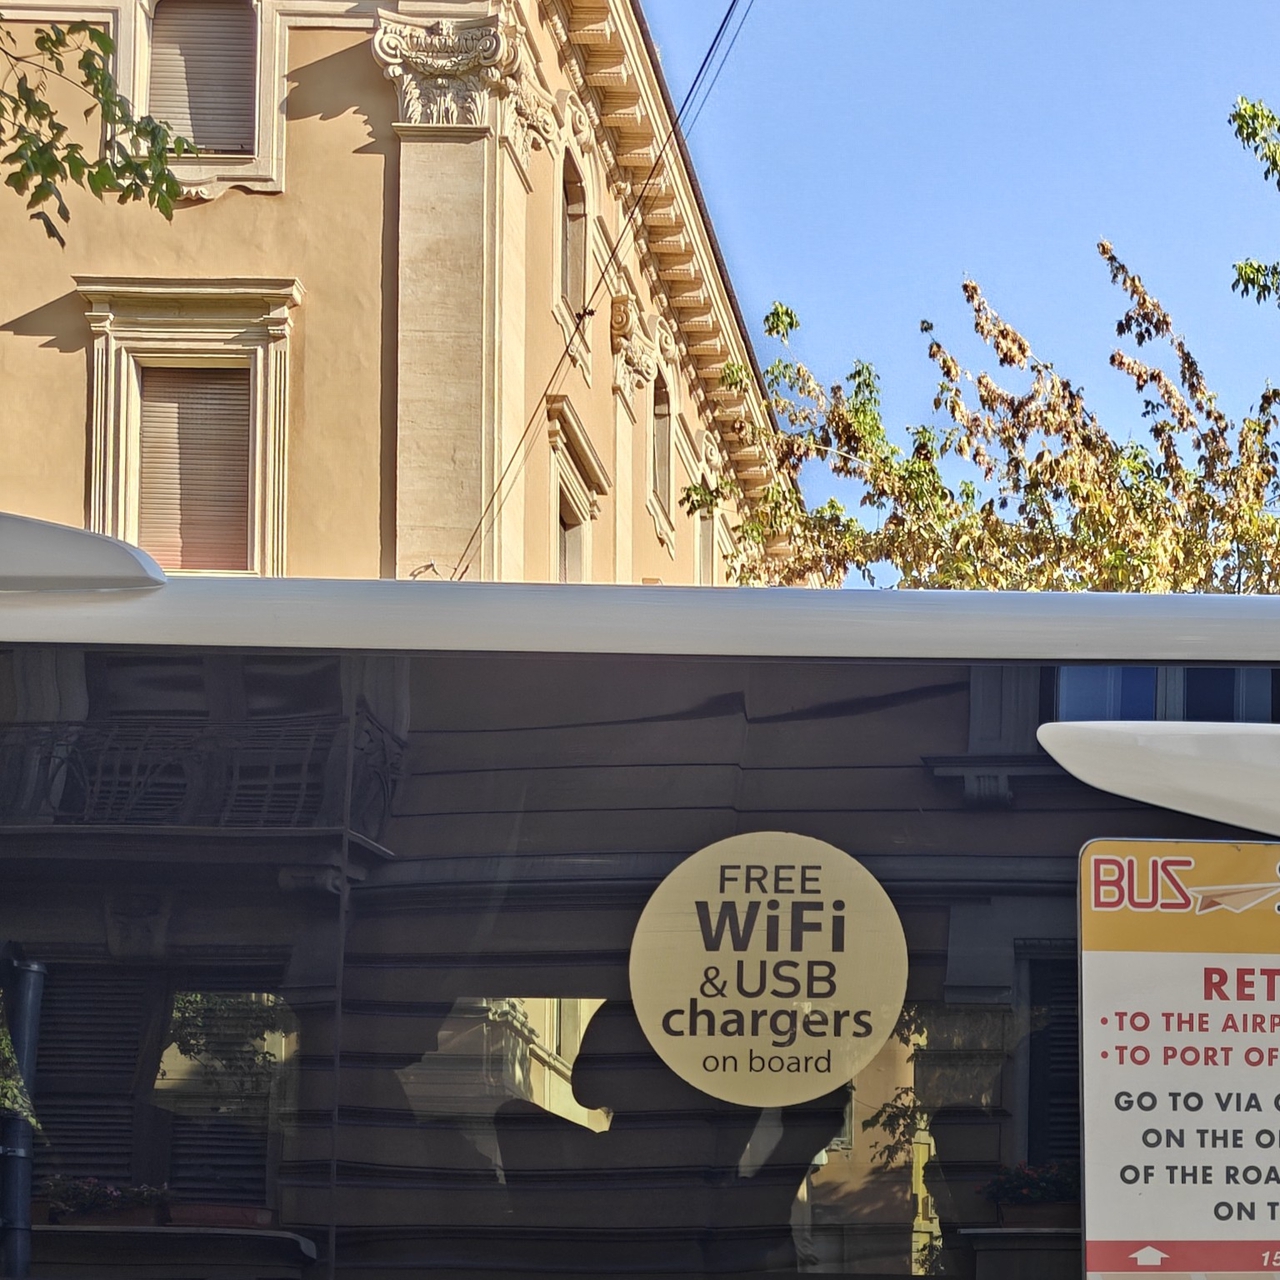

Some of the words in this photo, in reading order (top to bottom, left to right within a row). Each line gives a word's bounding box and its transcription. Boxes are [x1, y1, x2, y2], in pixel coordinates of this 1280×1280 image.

[719, 865, 822, 893] FREE
[1091, 855, 1194, 911] BUS
[695, 899, 845, 952] WiFi
[662, 998, 873, 1047] chargers
[1115, 1012, 1150, 1031] TO
[1162, 1013, 1209, 1032] THE
[703, 1055, 737, 1072] on
[749, 1049, 831, 1073] board
[1115, 1046, 1150, 1065] TO
[1164, 1046, 1233, 1066] PORT
[1245, 1047, 1278, 1066] OF
[1115, 1091, 1157, 1111] GO
[1169, 1092, 1203, 1111] TO
[1215, 1093, 1262, 1111] VIA
[1142, 1129, 1184, 1148] ON
[1196, 1129, 1243, 1148] THE
[1120, 1165, 1154, 1184] OF
[1166, 1166, 1212, 1184] THE
[1214, 1202, 1255, 1221] ON
